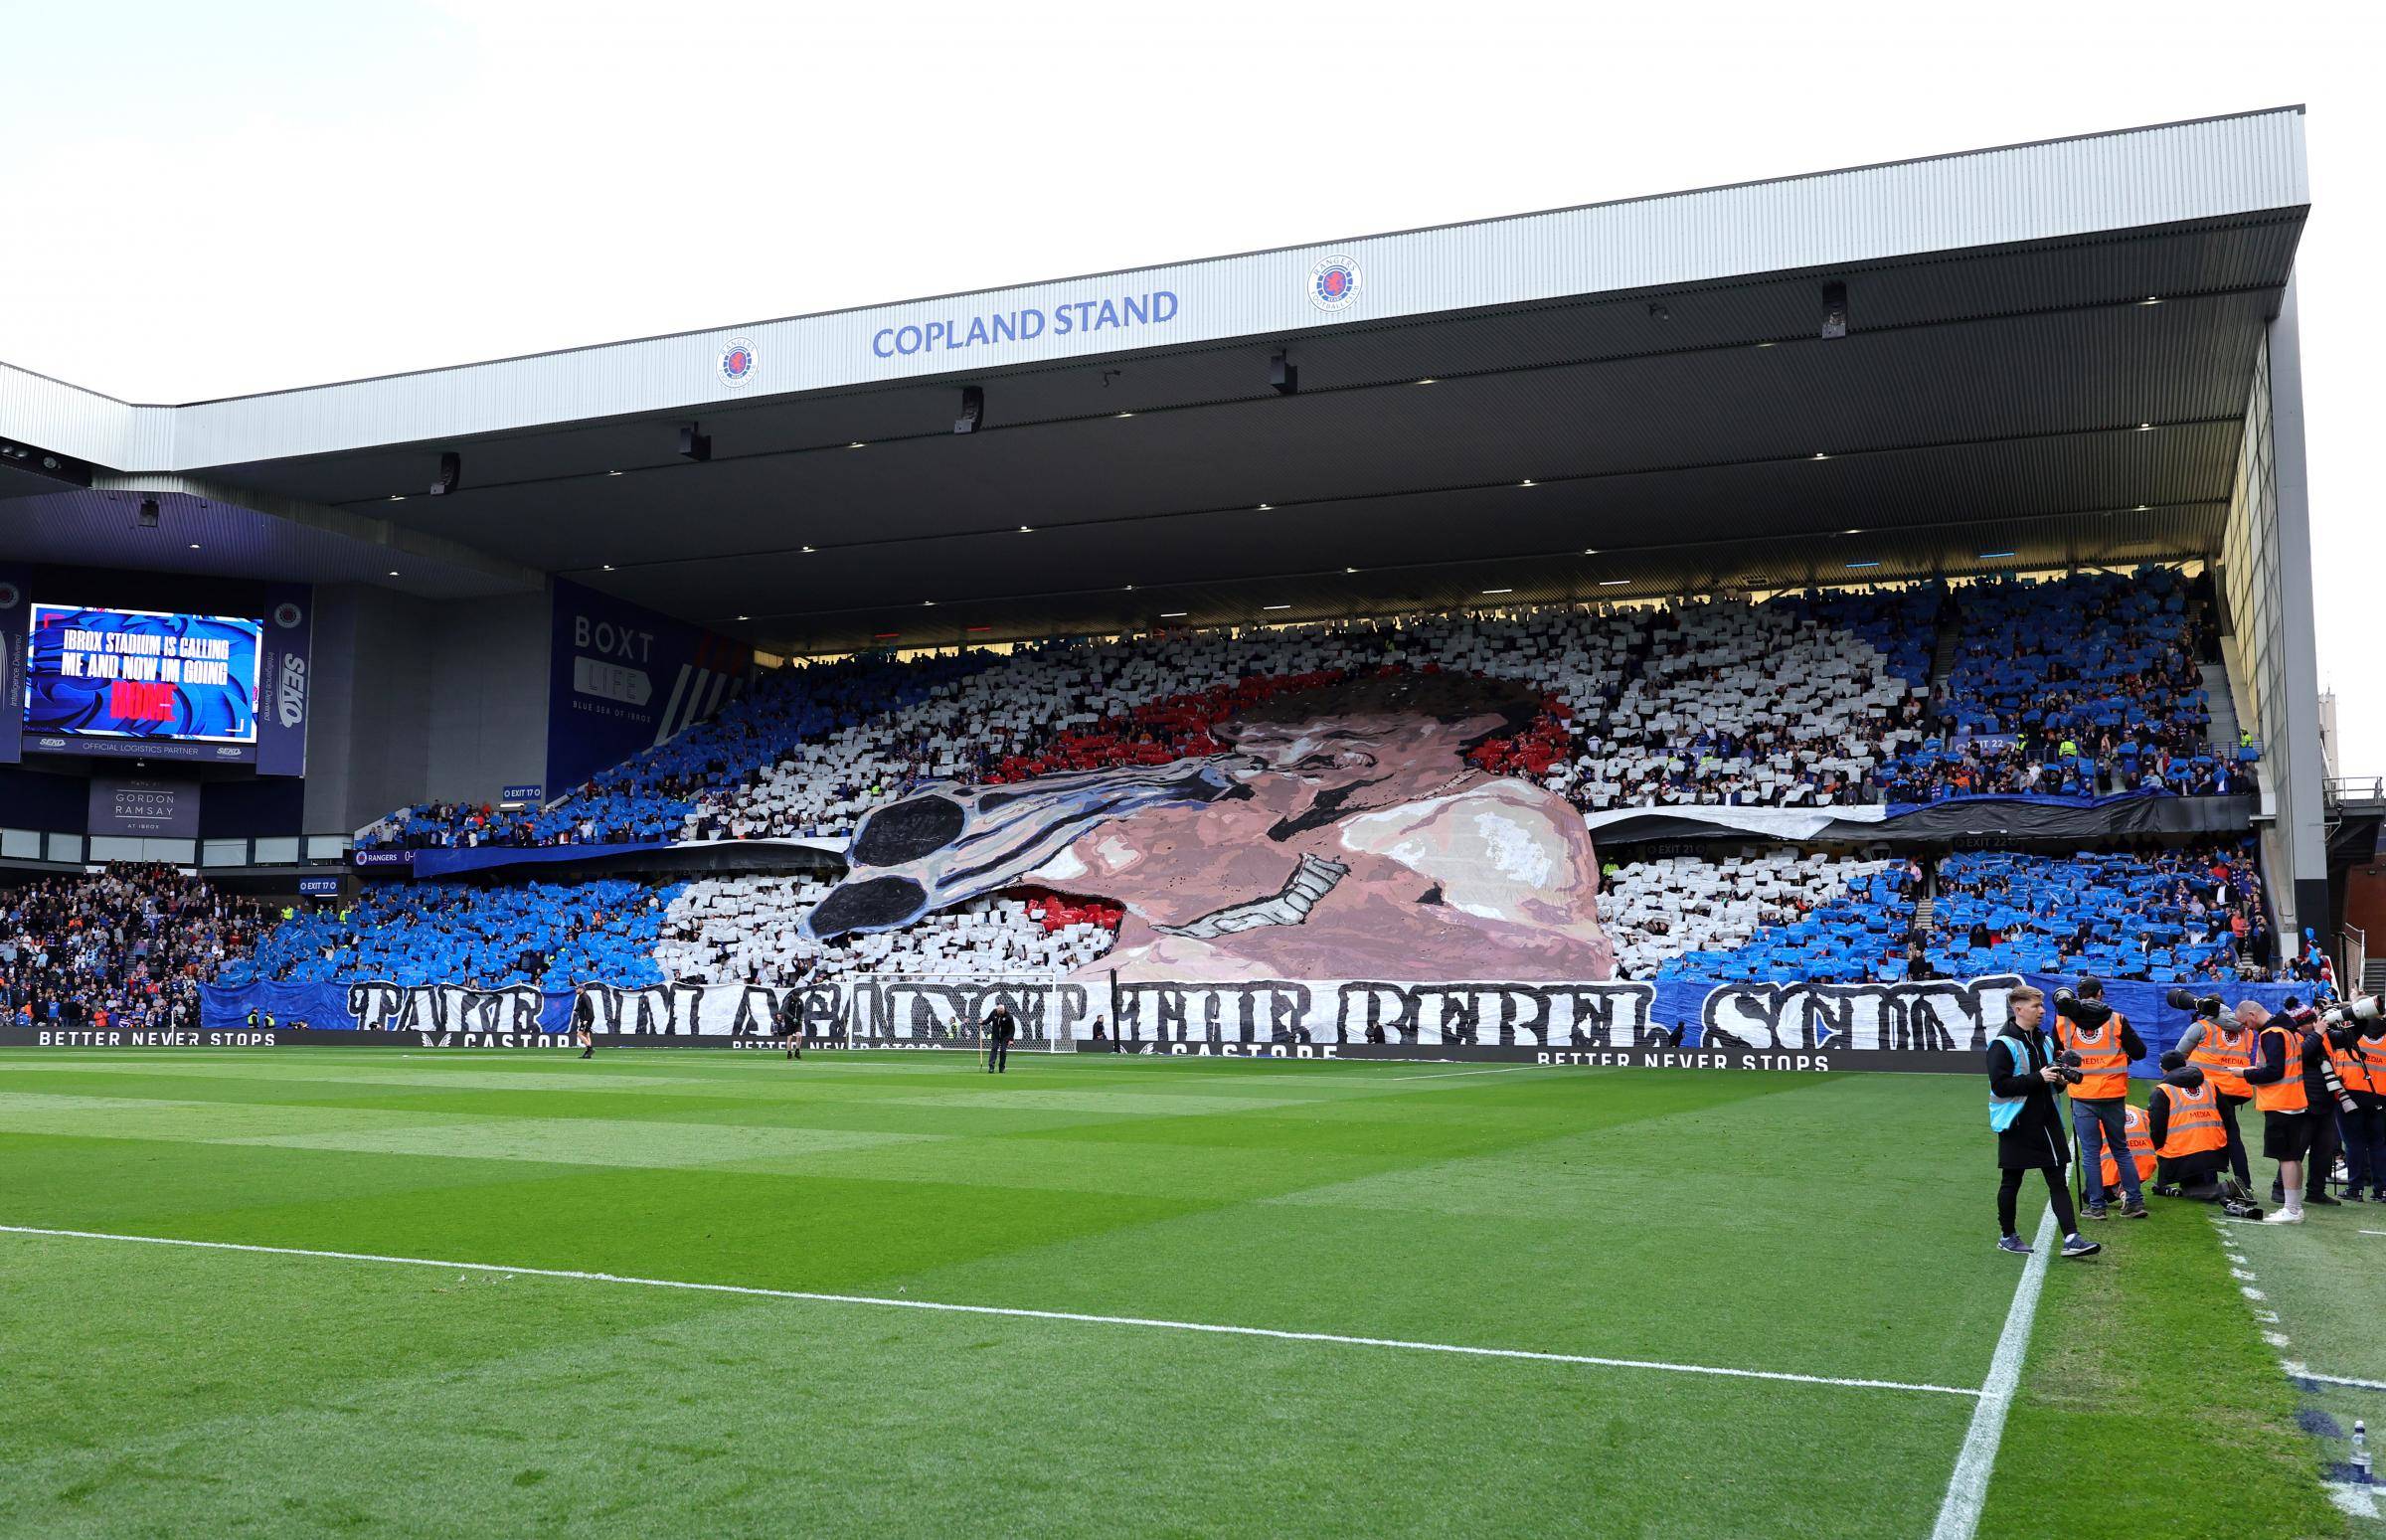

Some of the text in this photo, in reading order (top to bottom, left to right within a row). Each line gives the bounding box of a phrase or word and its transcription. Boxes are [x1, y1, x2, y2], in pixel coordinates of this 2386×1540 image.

[1313, 257, 1357, 275] RANGERS
[872, 290, 1178, 358] COPLAND STAND
[63, 628, 230, 660] IBROX STADIUM IS CALLING
[575, 614, 654, 663] BOXT
[61, 651, 229, 686] ME AND NOW IM GOING
[588, 662, 637, 700] LIFE
[281, 652, 305, 726] SEKO
[573, 700, 593, 711] BLUE
[39, 738, 67, 747] SEKO
[83, 742, 199, 756] OFFICIAL LOGISTICS PARTNER
[1991, 739, 2003, 748] 22
[216, 747, 243, 757] SEKO
[115, 793, 174, 804] GORDON
[115, 805, 173, 816] RAMSAY
[1658, 844, 1694, 854] EXIT 21
[1966, 837, 1988, 847] EXIT
[39, 1031, 275, 1046] BETTER NEVER STOPS
[1537, 1052, 1829, 1072] BETTER NEVER STOPS
